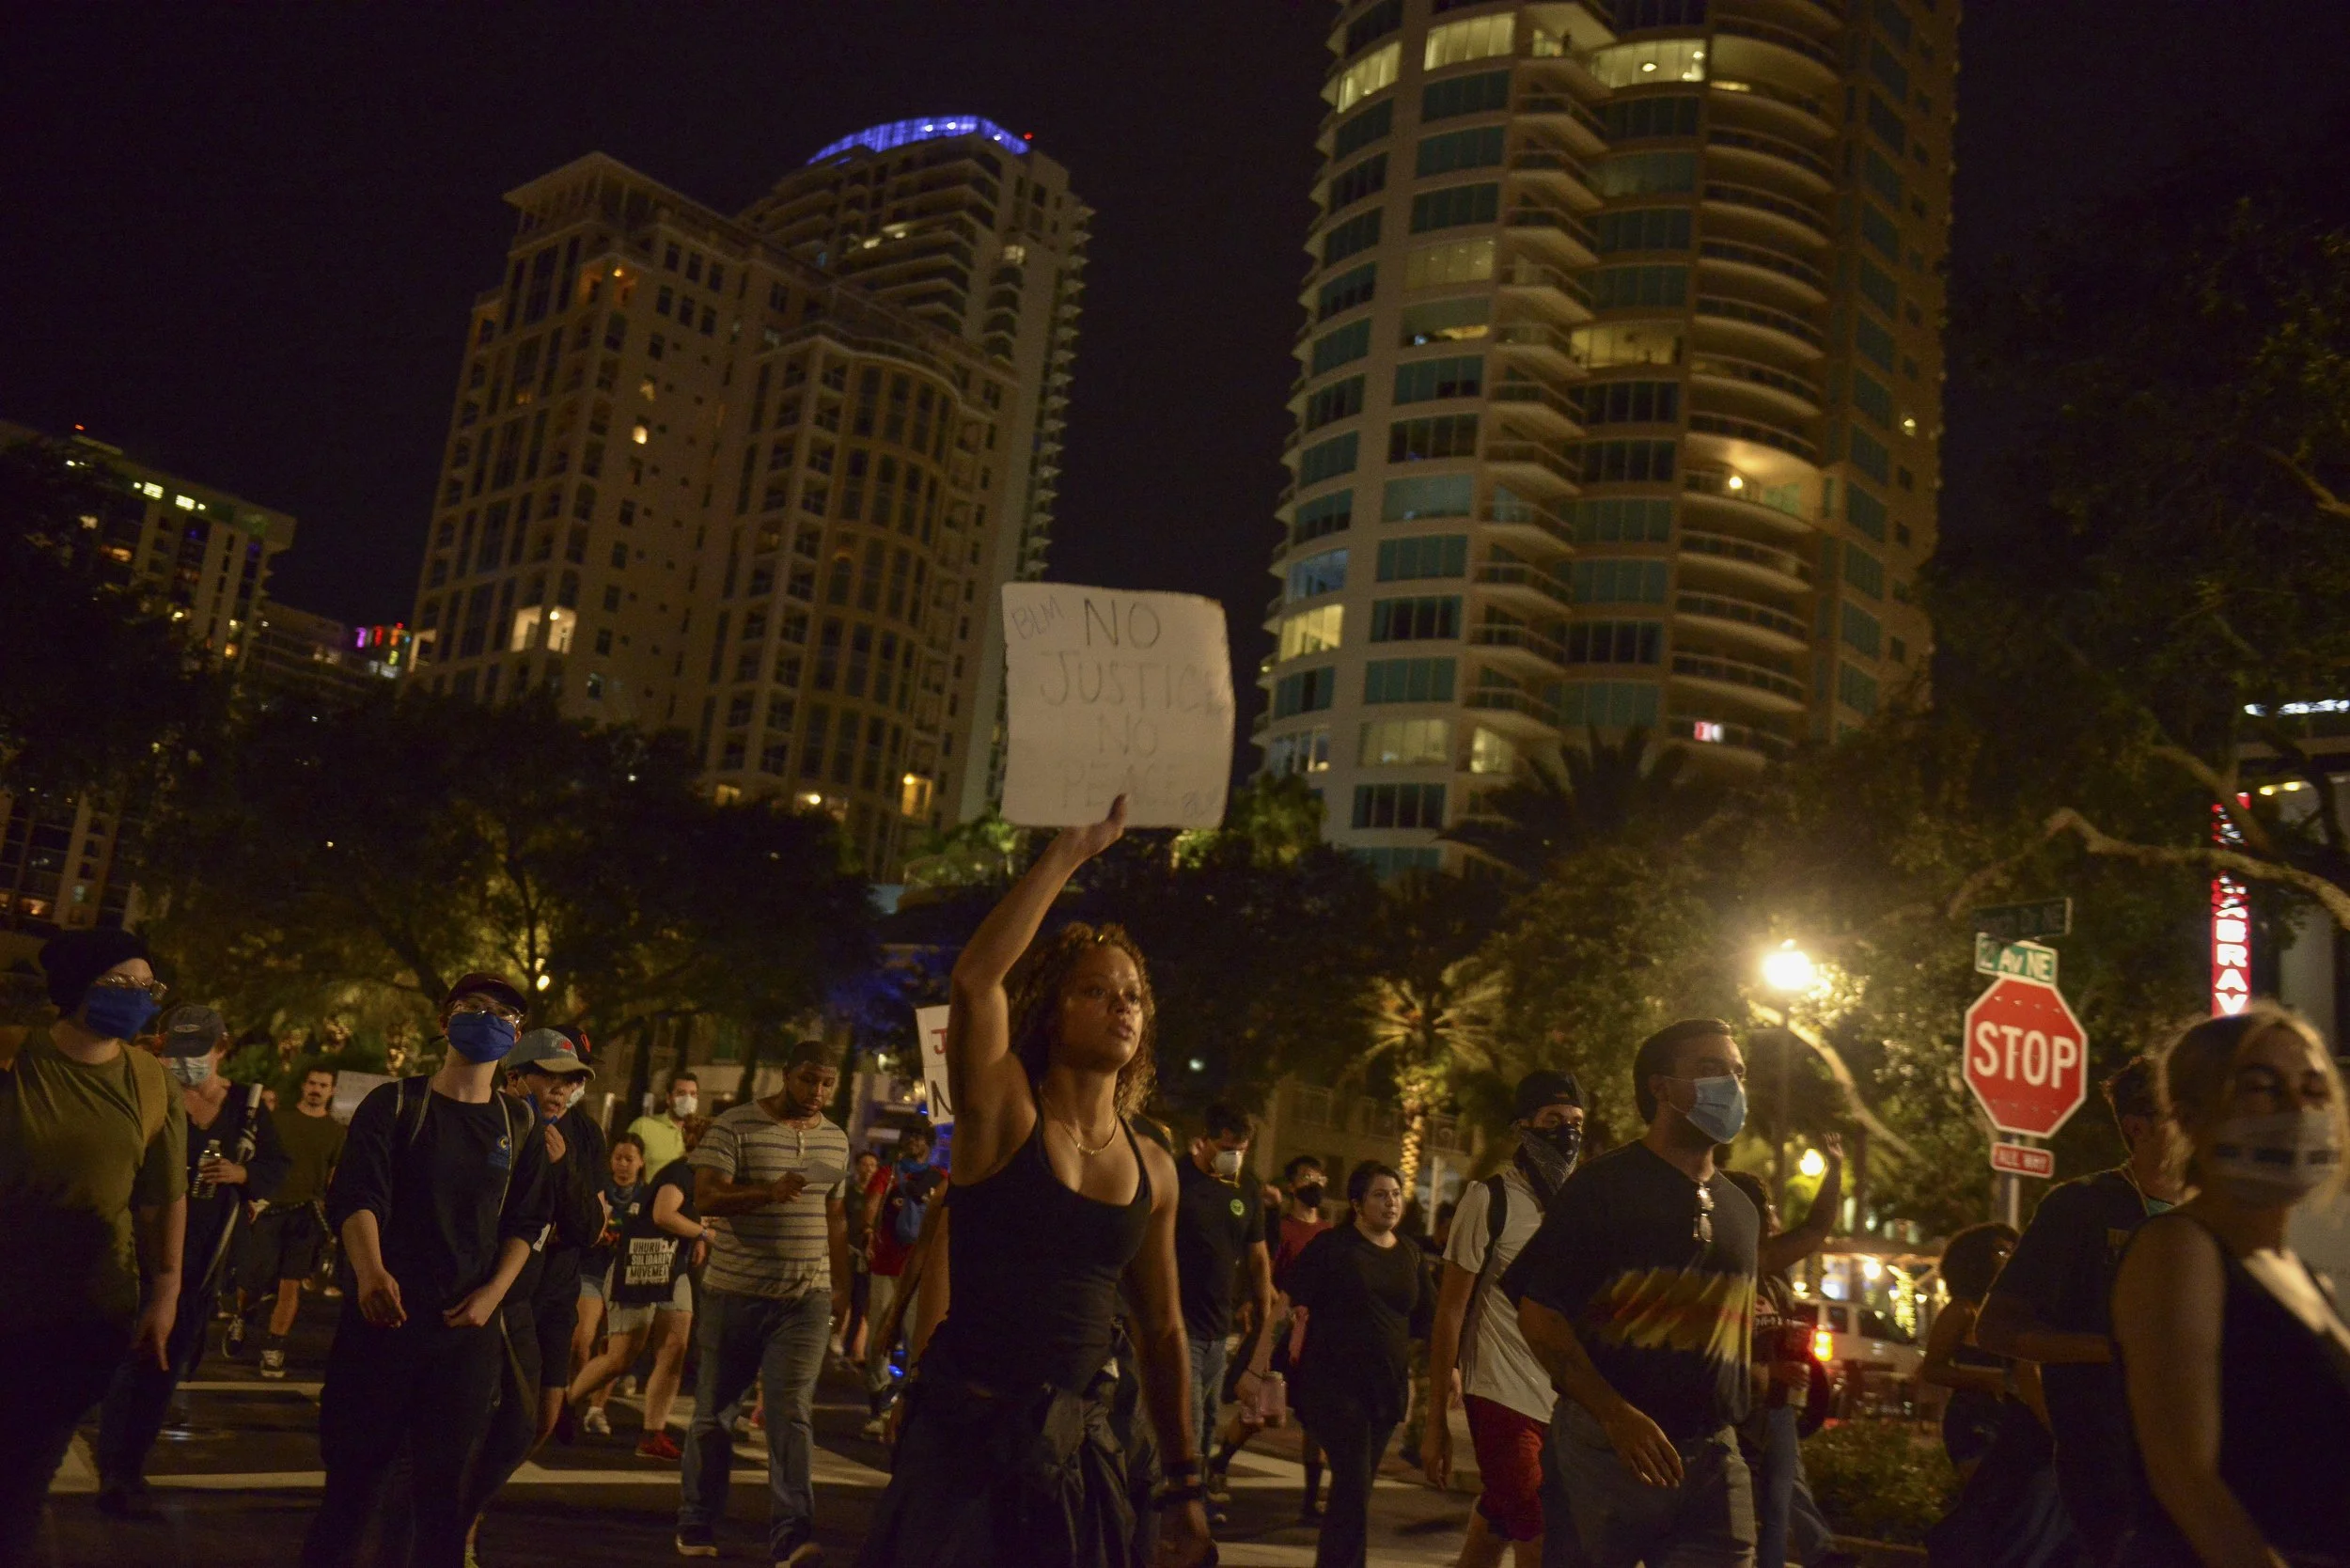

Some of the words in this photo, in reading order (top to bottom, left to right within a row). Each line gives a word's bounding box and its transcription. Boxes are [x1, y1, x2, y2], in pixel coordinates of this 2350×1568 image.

[1010, 594, 1065, 640] BLM
[1083, 597, 1162, 650] NO
[1097, 713, 1160, 758] NO
[2026, 949, 2052, 981] NE
[931, 1027, 948, 1055] J
[1972, 1020, 2078, 1090] STOP
[931, 1079, 953, 1118] N
[633, 1241, 661, 1252] UHURU
[630, 1265, 666, 1278] MOVEME
